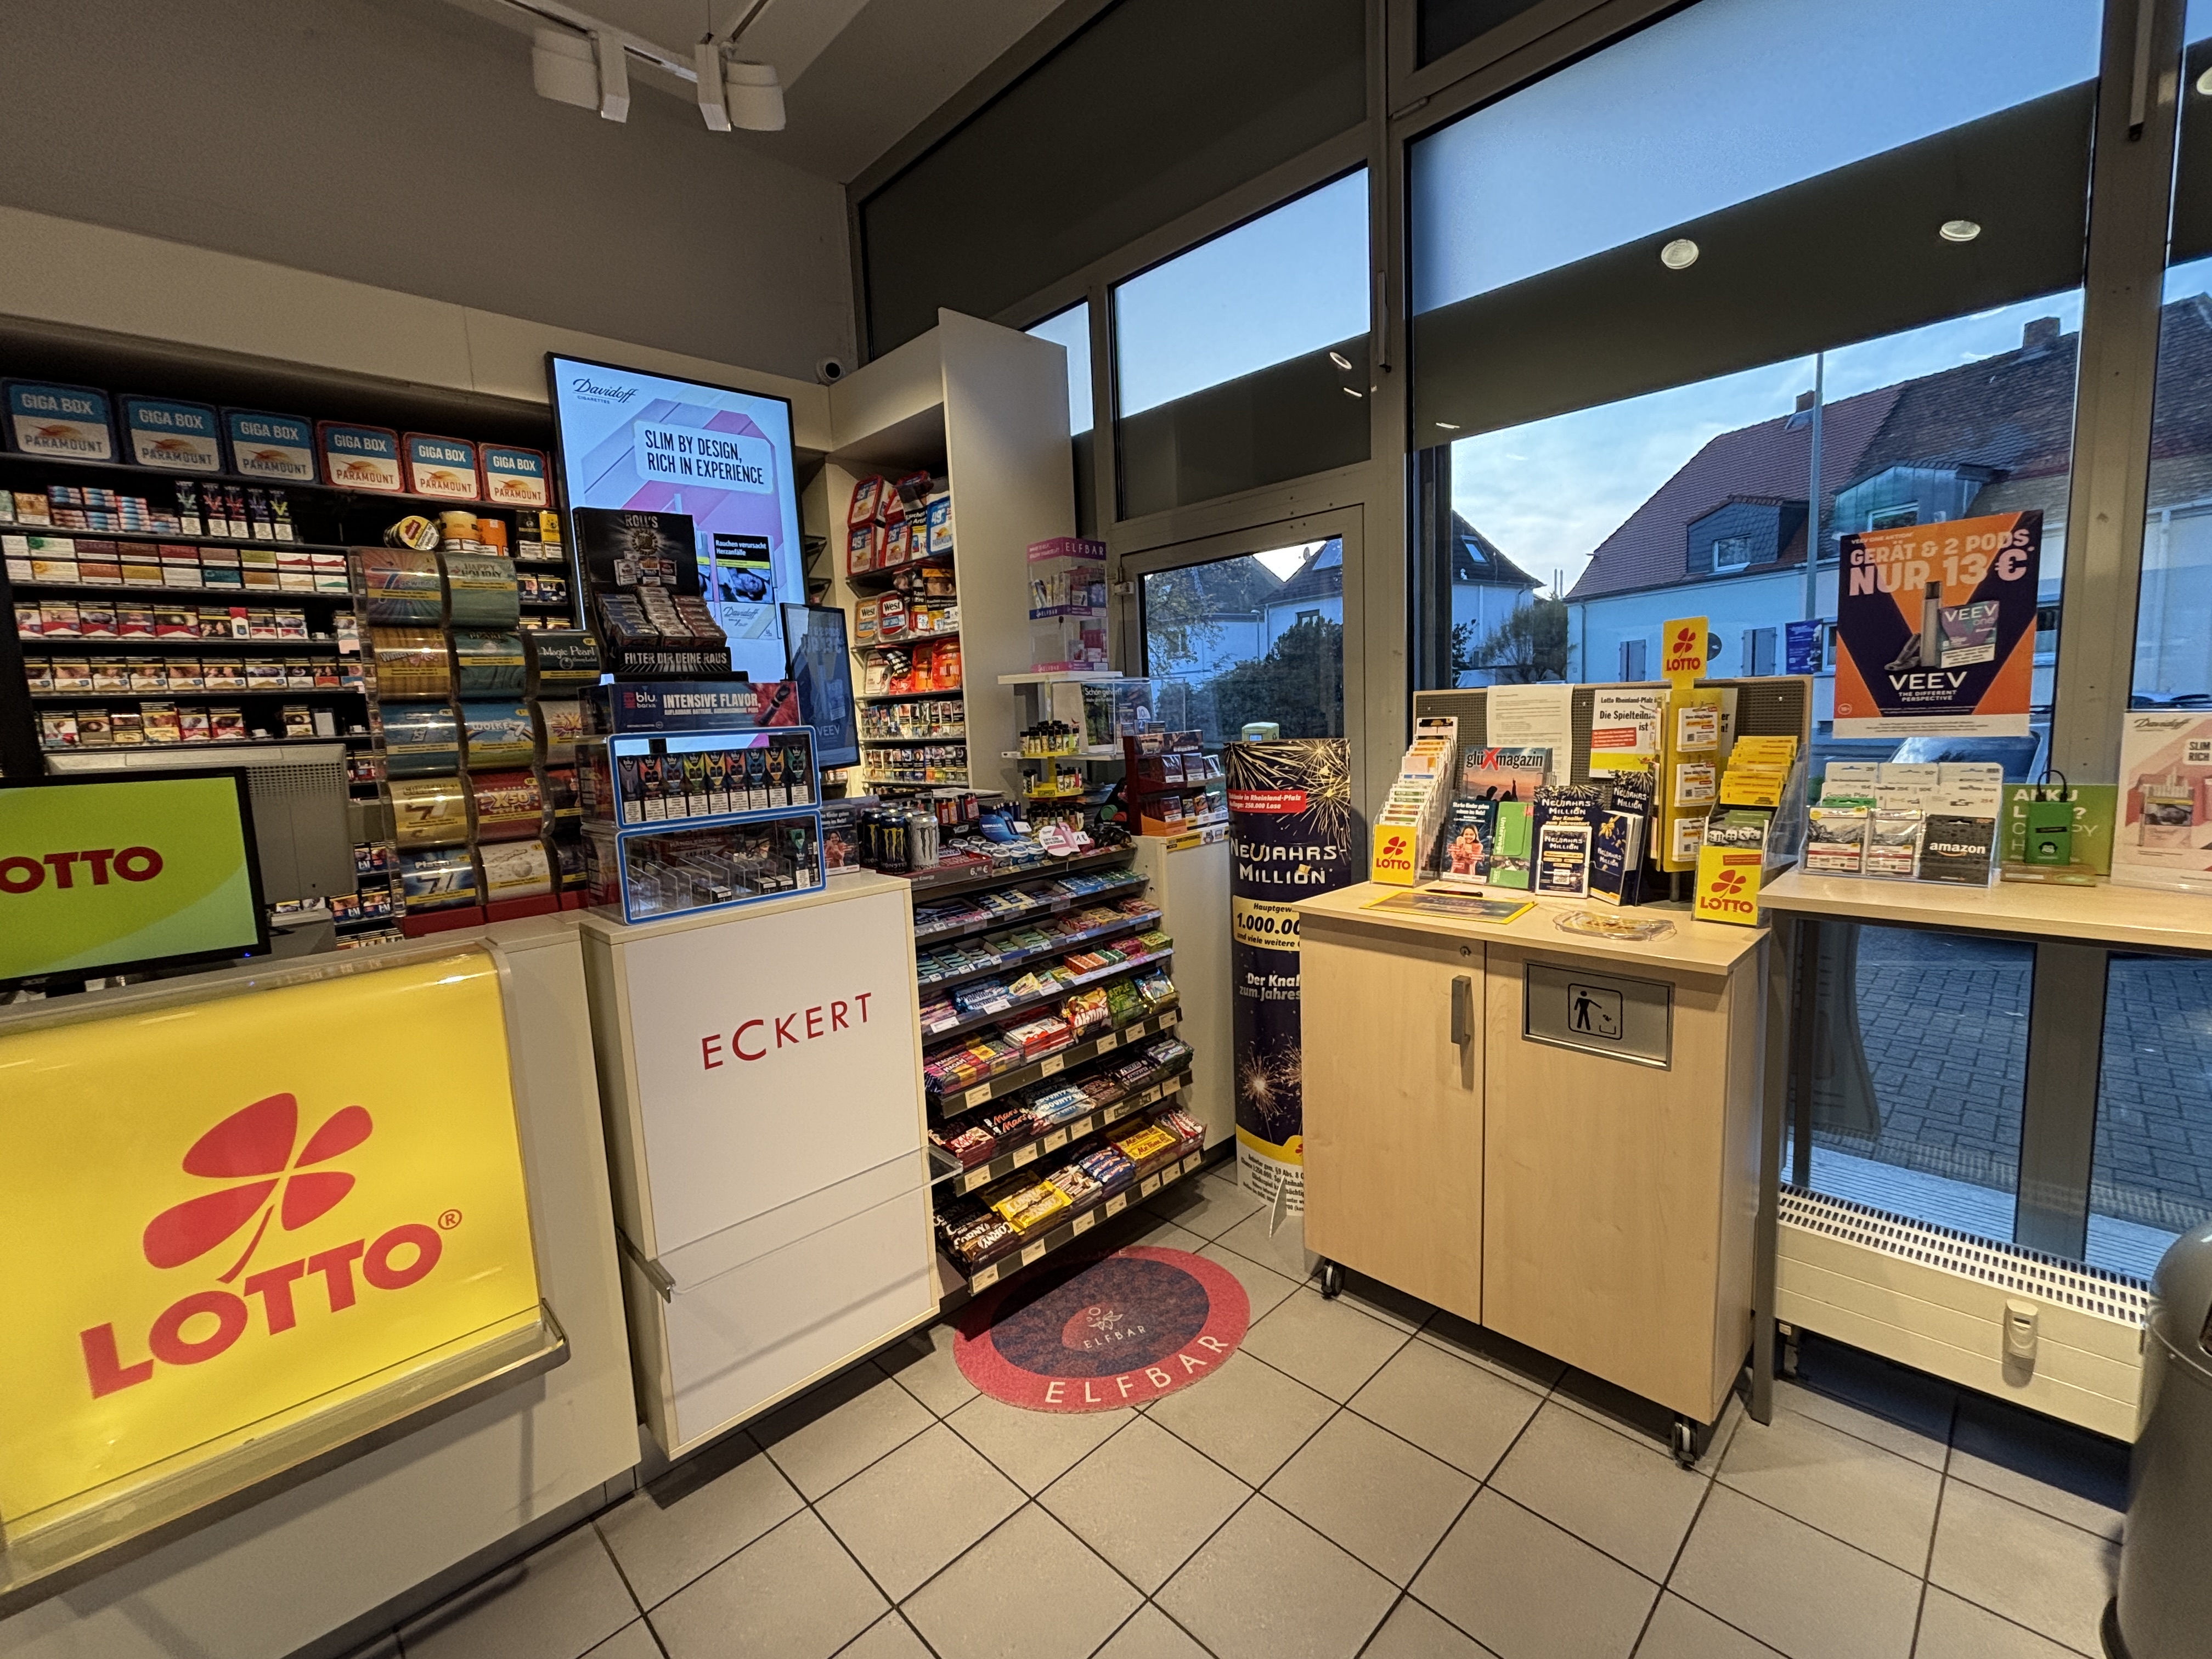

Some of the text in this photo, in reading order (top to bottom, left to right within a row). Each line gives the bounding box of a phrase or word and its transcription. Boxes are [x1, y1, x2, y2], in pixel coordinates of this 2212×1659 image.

[573, 378, 639, 403] Davidoff
[21, 393, 93, 415] GIGA BOX
[577, 395, 610, 404] CIGARETTES
[138, 409, 204, 430] GIGA BOX
[240, 422, 299, 440] GIGA BOX
[25, 435, 103, 453] PARAMOUNT
[334, 434, 387, 452] GIGA BOX
[645, 430, 742, 464] SLIM BY DESIGN,
[142, 448, 213, 465] PARAMOUNT
[419, 445, 466, 462] GIGA BOX
[242, 459, 307, 475] PARAMOUNT
[493, 456, 536, 471] GIGA BOX
[647, 452, 764, 485] RICH IN EXPERIENCE
[336, 469, 394, 484] PARAMOUNT
[420, 478, 472, 493] PARAMOUNT
[494, 488, 541, 500] PARAMOUNT
[625, 515, 658, 528] ROLL'S
[715, 539, 766, 549] Rauchen verursacht
[1066, 542, 1103, 555] ELFBAR
[716, 548, 746, 556] Herzanfälle
[1850, 540, 1916, 566] GERÄT
[1921, 540, 1937, 558] &
[1945, 538, 1959, 554] 2
[1849, 560, 1931, 596] NUR
[1943, 554, 1988, 587] 13
[861, 608, 876, 616] West
[884, 602, 901, 612] West
[1945, 604, 1997, 622] VEEV
[1973, 617, 1995, 626] one
[541, 646, 595, 659] Magic Pearl
[625, 652, 727, 664] FILTER DIR DEINE RAUS
[1666, 658, 1701, 672] LOTTO
[1888, 672, 1968, 690] VEEV
[636, 692, 656, 702] blu
[1085, 687, 1102, 696] Schon
[663, 693, 761, 708] INTENSIVE FLAVOR,
[1600, 711, 1611, 719] Die
[472, 721, 526, 737] WOLKE 7
[817, 724, 840, 736] VEEV
[1639, 723, 1649, 731] ist
[2134, 718, 2193, 730] Davidoff
[2189, 742, 2211, 751] SLIM
[2188, 752, 2210, 761] RICH
[1549, 807, 1586, 815] MILLION
[1617, 798, 1643, 811] MILLION
[1497, 816, 1506, 854] Unterwegs
[1230, 838, 1347, 862] NEUJAHRS-
[1929, 842, 1986, 855] amazon
[415, 859, 452, 869] Platin
[1376, 857, 1411, 871] LOTTO
[1239, 863, 1325, 884] MILLION
[1254, 902, 1295, 913] Hauptgew
[1701, 896, 1753, 913] LOTTO
[1248, 935, 1262, 944] viele
[1265, 939, 1295, 947] weitere
[1248, 973, 1265, 986] Der
[1108, 983, 1131, 998] APPLE
[1239, 986, 1257, 998] zum
[702, 992, 871, 1070] ECKERT
[943, 1058, 967, 1073] MAOAM
[1044, 1094, 1073, 1111] BOUNTY
[994, 1108, 1019, 1125] Mars
[1002, 1114, 1028, 1133] Mars
[955, 1132, 976, 1148] KitKat
[1283, 1169, 1294, 1178] Abs.
[1006, 1188, 1041, 1212] CORNY
[977, 1221, 1013, 1249] CORNY
[1083, 1325, 1146, 1348] ELFBAR
[1045, 1335, 1228, 1404] ELFBAR
